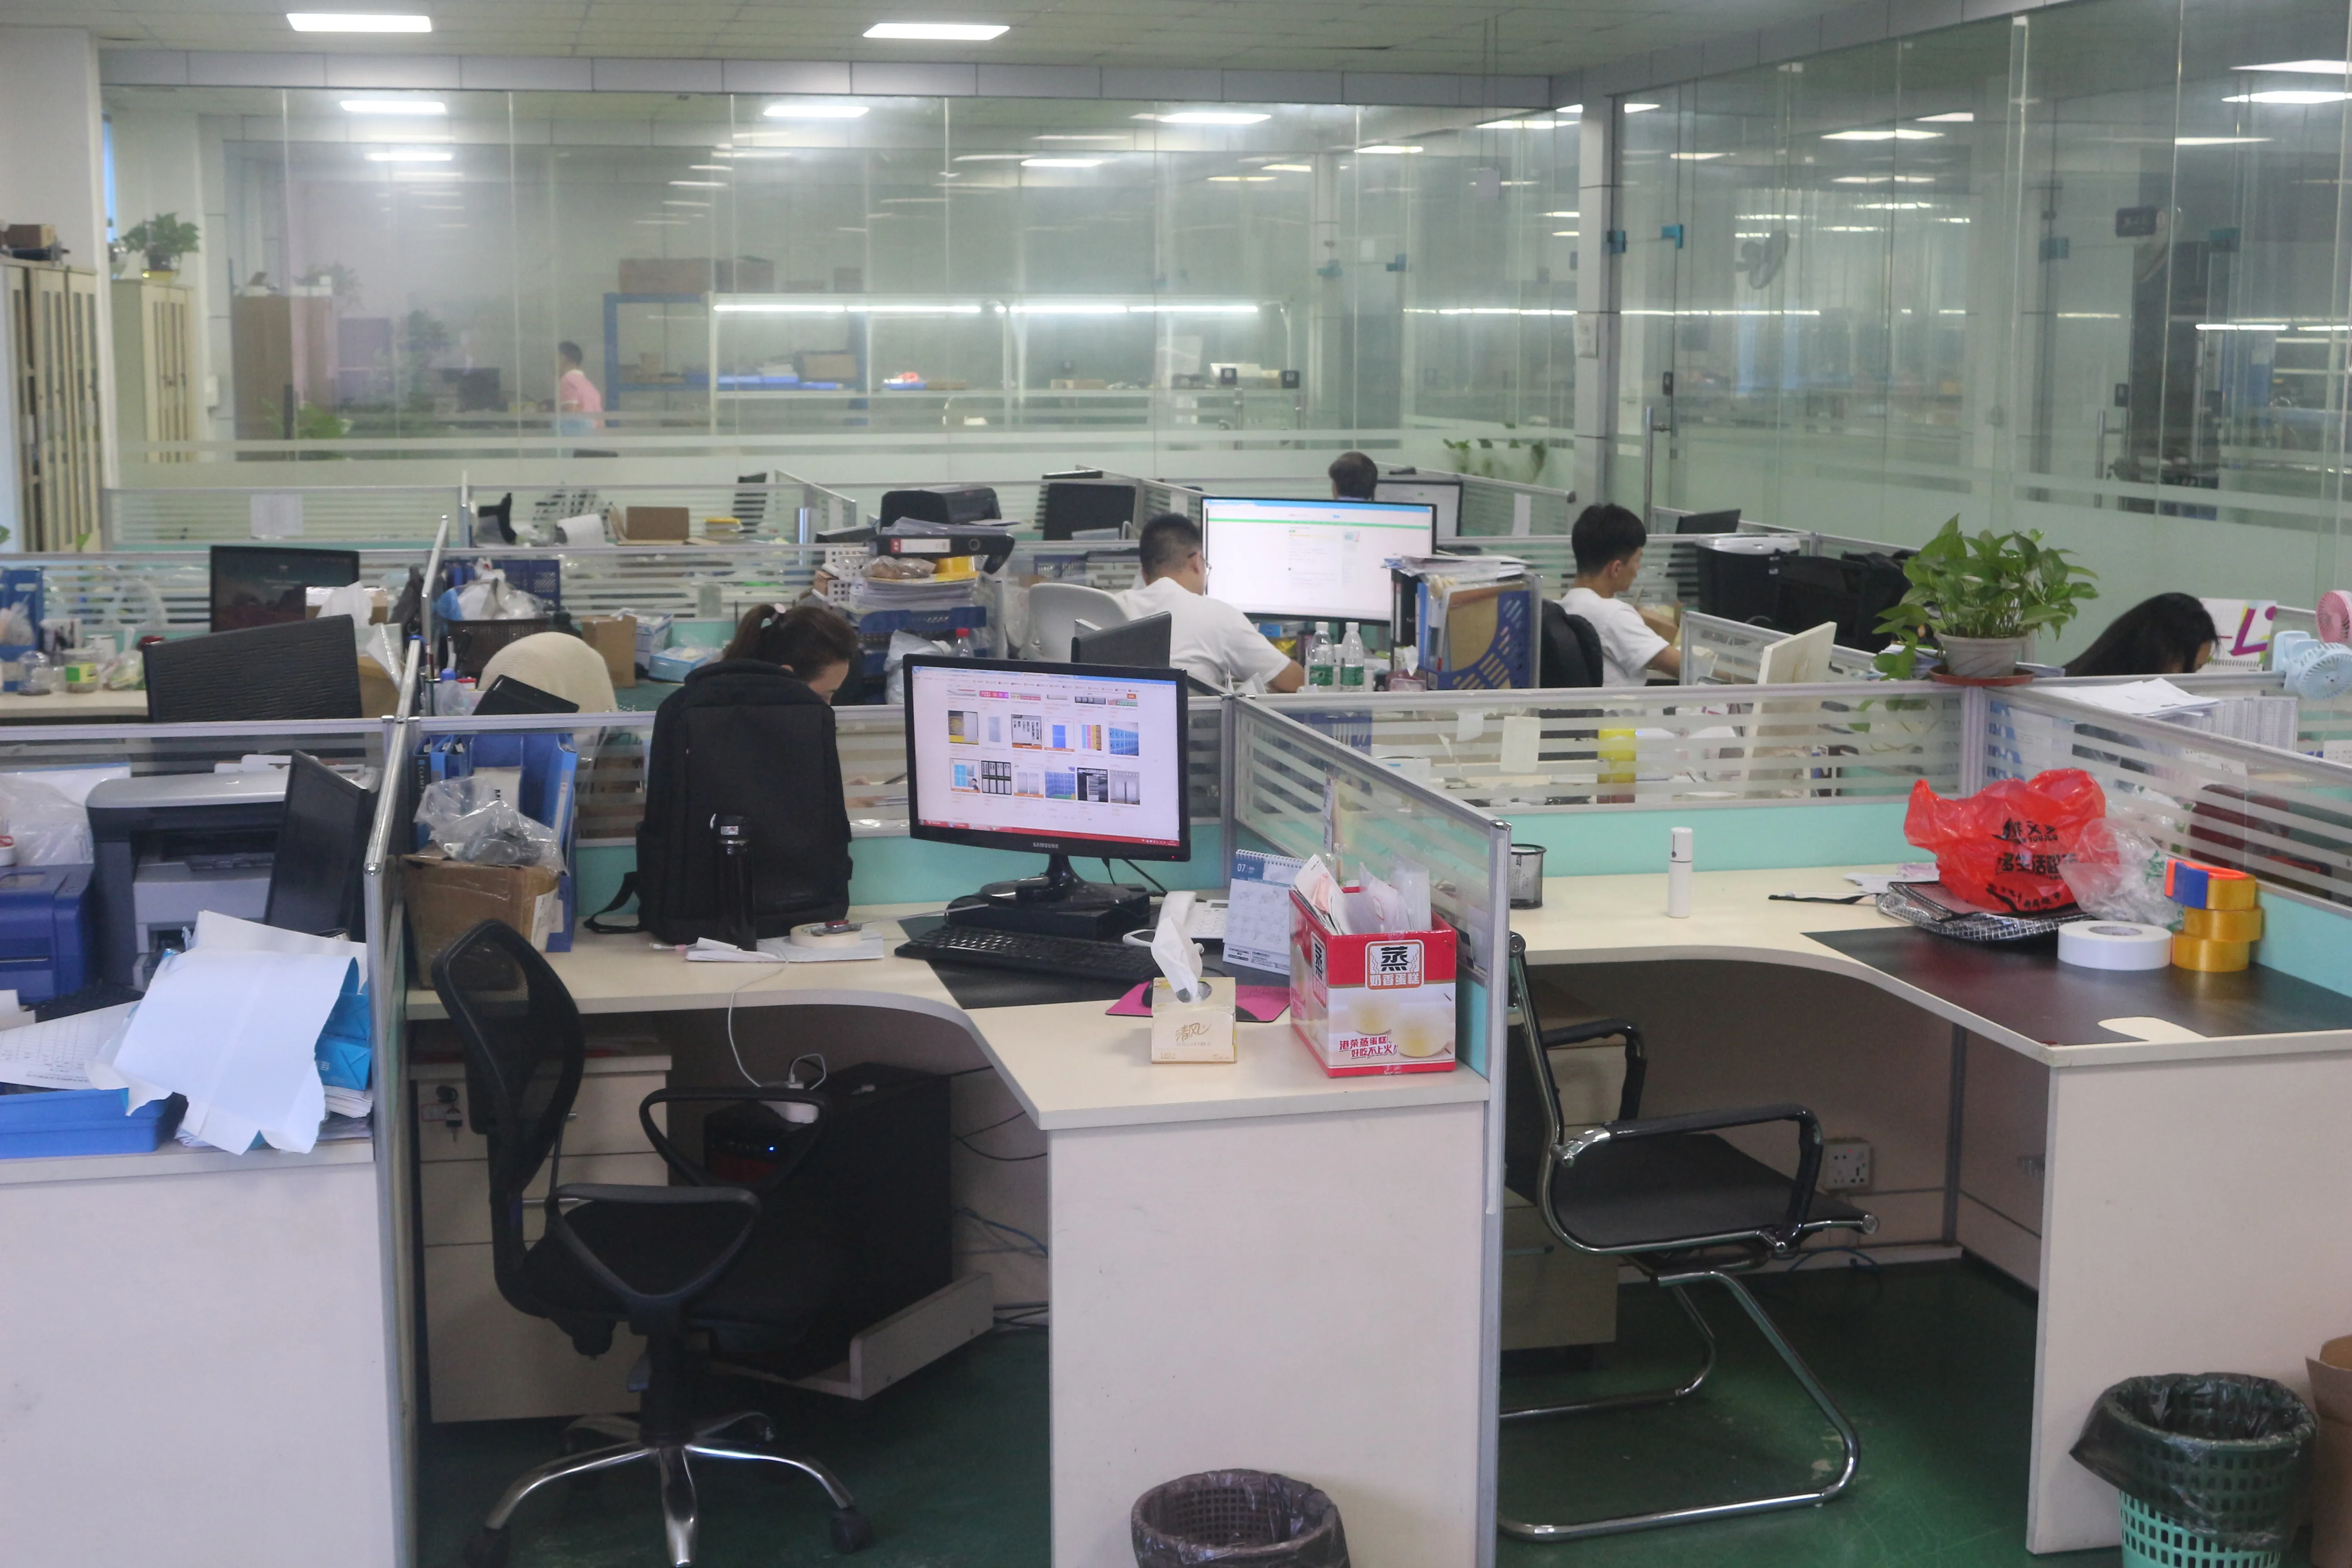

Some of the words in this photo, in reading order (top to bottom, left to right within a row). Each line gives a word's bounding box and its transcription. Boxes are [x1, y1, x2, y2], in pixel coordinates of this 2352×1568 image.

[1237, 863, 1246, 872] 07
[1381, 946, 1410, 972] 蒸
[1370, 973, 1420, 986] 奶香蛋糕
[1175, 1022, 1211, 1042] 清风
